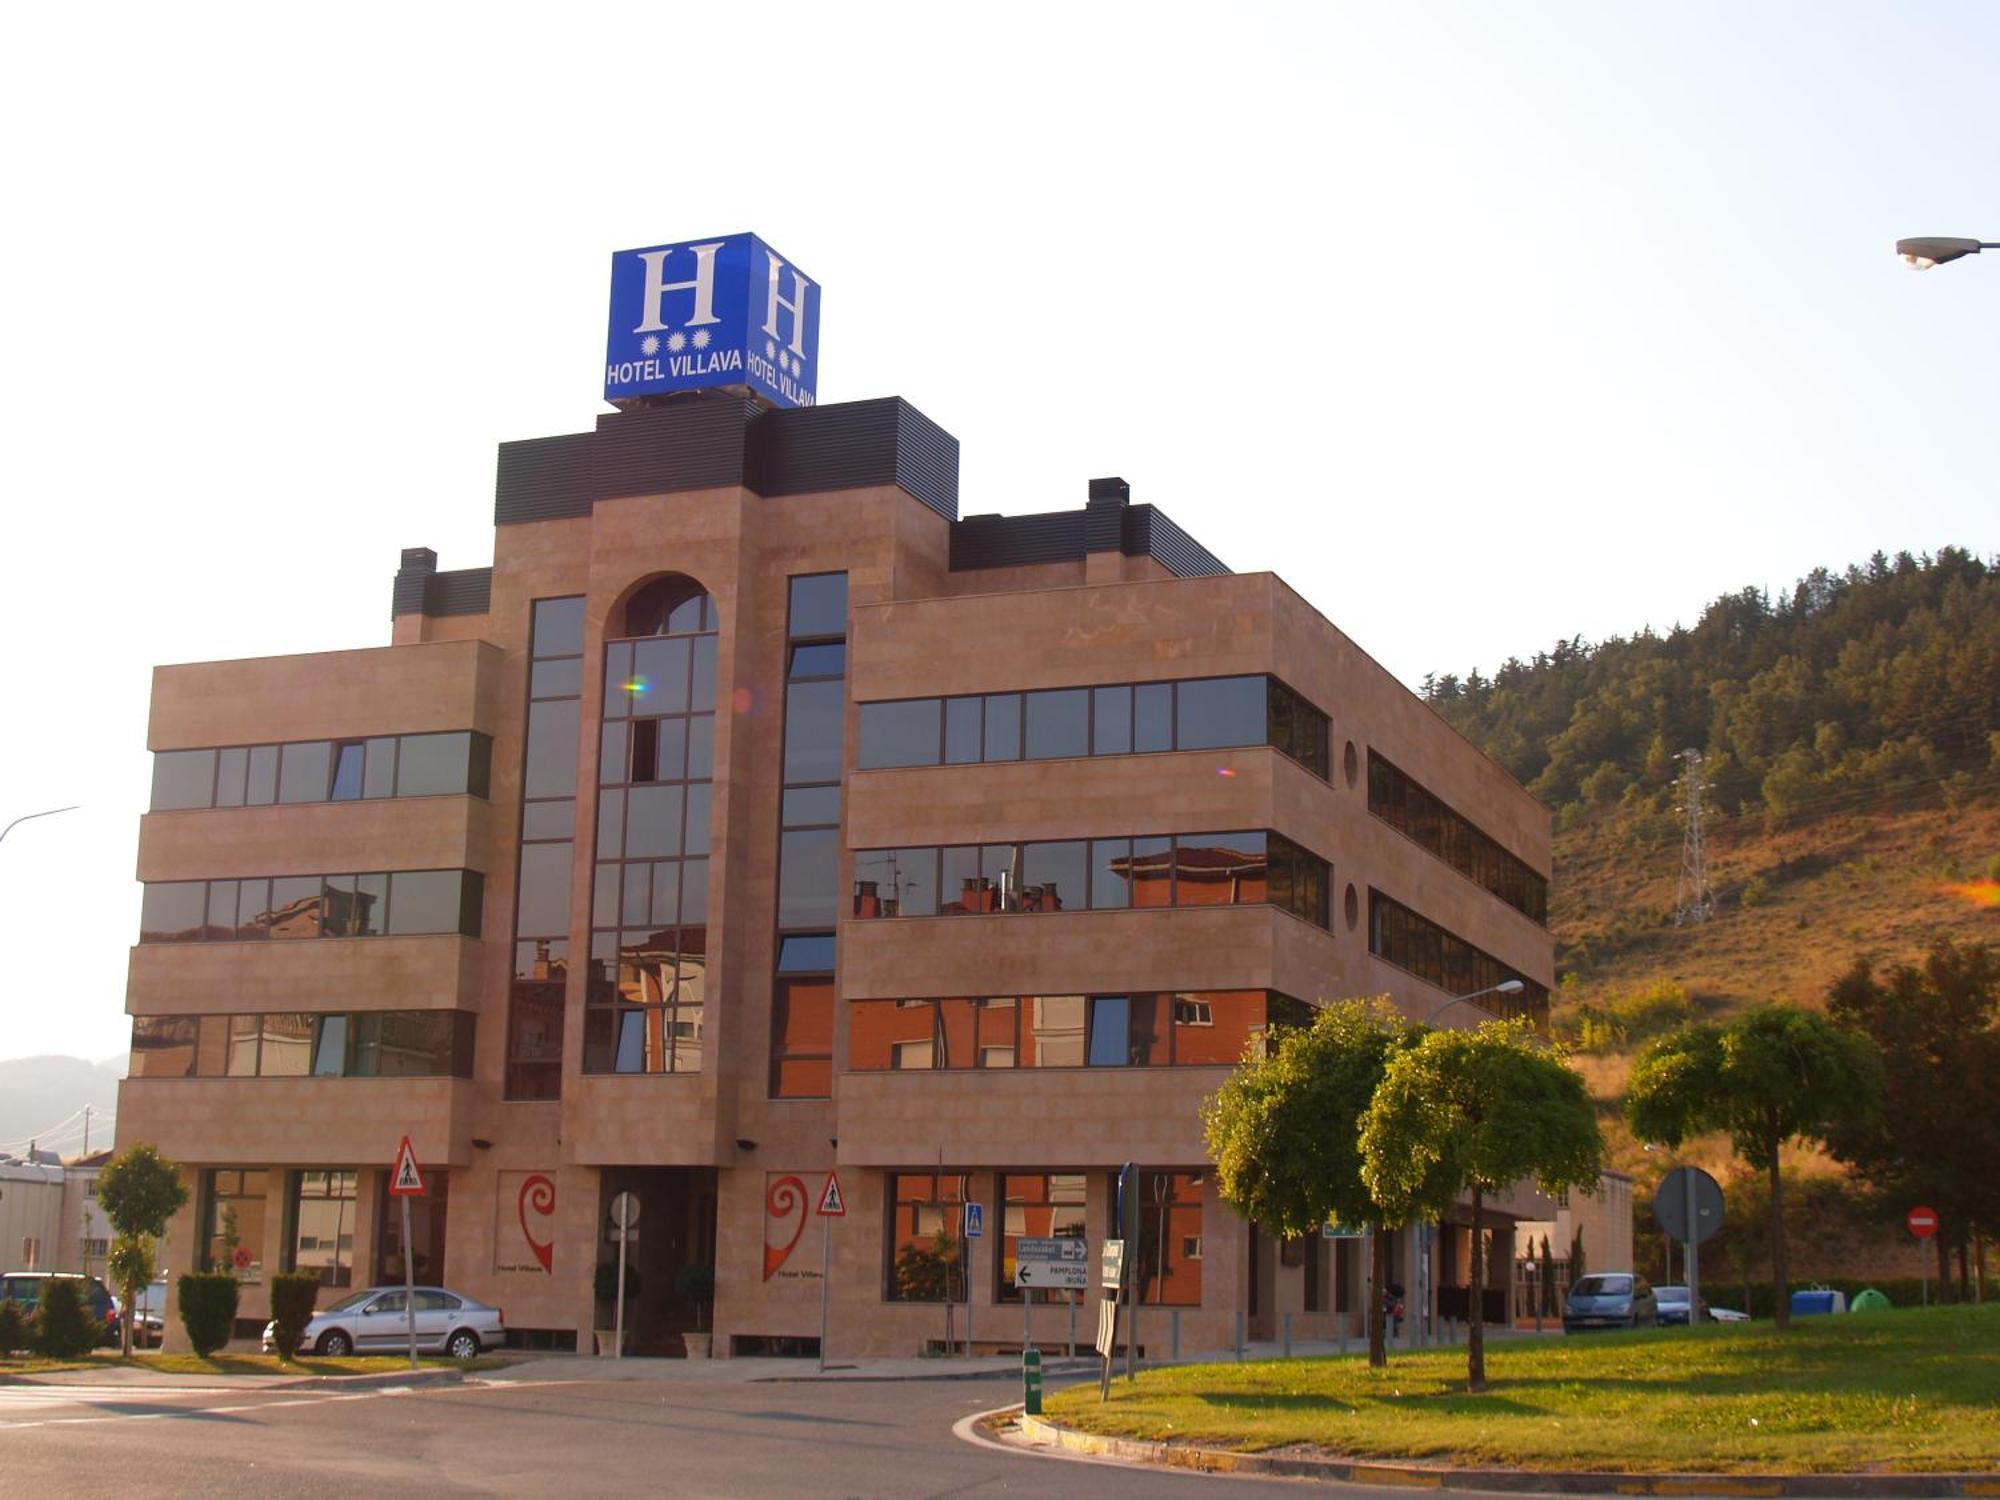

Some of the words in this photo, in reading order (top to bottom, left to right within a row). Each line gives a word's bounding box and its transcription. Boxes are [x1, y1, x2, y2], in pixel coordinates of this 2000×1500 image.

[633, 242, 725, 333] H
[761, 249, 810, 359] H
[607, 360, 665, 385] HOTEL
[669, 350, 742, 377] VILLAVA
[747, 351, 778, 389] HOTEL
[1050, 1266, 1087, 1275] PAMPLONA
